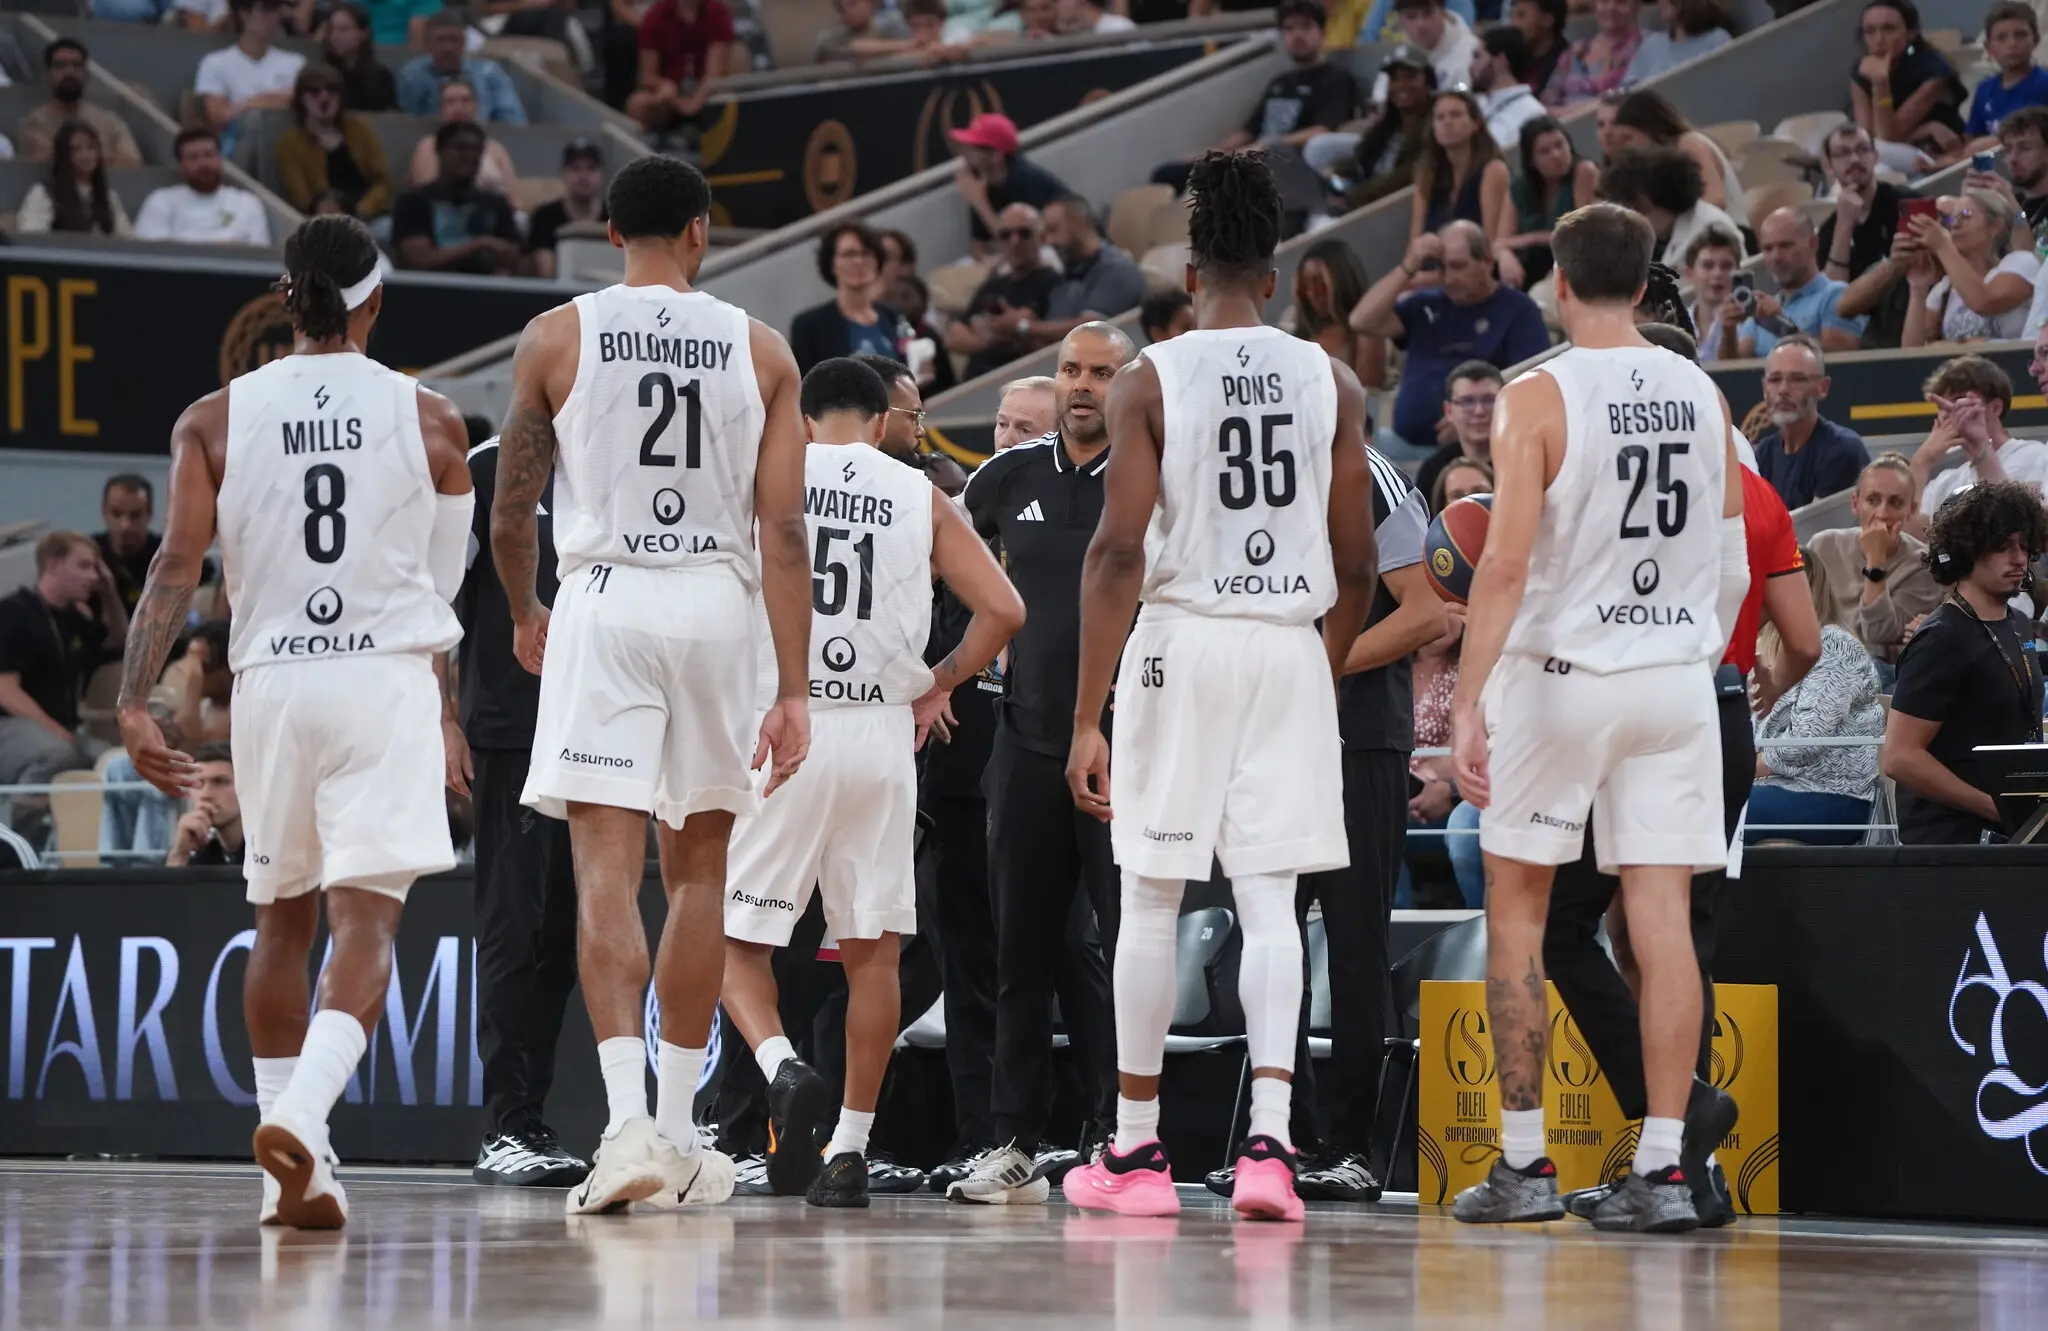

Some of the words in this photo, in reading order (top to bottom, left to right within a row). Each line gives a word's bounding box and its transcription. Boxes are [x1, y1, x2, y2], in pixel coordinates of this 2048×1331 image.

[8, 275, 99, 435] PE
[600, 332, 732, 371] BOLOMBOY
[1222, 373, 1283, 406] PONS
[638, 371, 701, 469] 21
[1608, 401, 1696, 435] BESSON
[282, 417, 363, 455] MILLS
[1218, 413, 1296, 510] 35
[1617, 443, 1690, 539] 25
[304, 463, 346, 564] 8
[804, 485, 893, 527] WATERS
[623, 533, 718, 553] VEOLIA
[585, 564, 612, 593] 21
[812, 526, 874, 620] 51
[1214, 575, 1311, 595] VEOLIA
[1597, 604, 1694, 626] VEOLIA
[270, 632, 376, 655] VEOLIA
[1142, 656, 1164, 688] 35
[808, 679, 885, 703] EOLIA
[559, 748, 634, 768] Assurnoo
[732, 889, 794, 912] Assurnoo
[1201, 927, 1213, 940] 20
[1457, 1091, 1487, 1117] FULFIL
[1560, 1093, 1591, 1119] FULFIL
[1445, 1126, 1498, 1143] SUPERCOUPE
[1548, 1128, 1603, 1146] SUPERCOUPE
